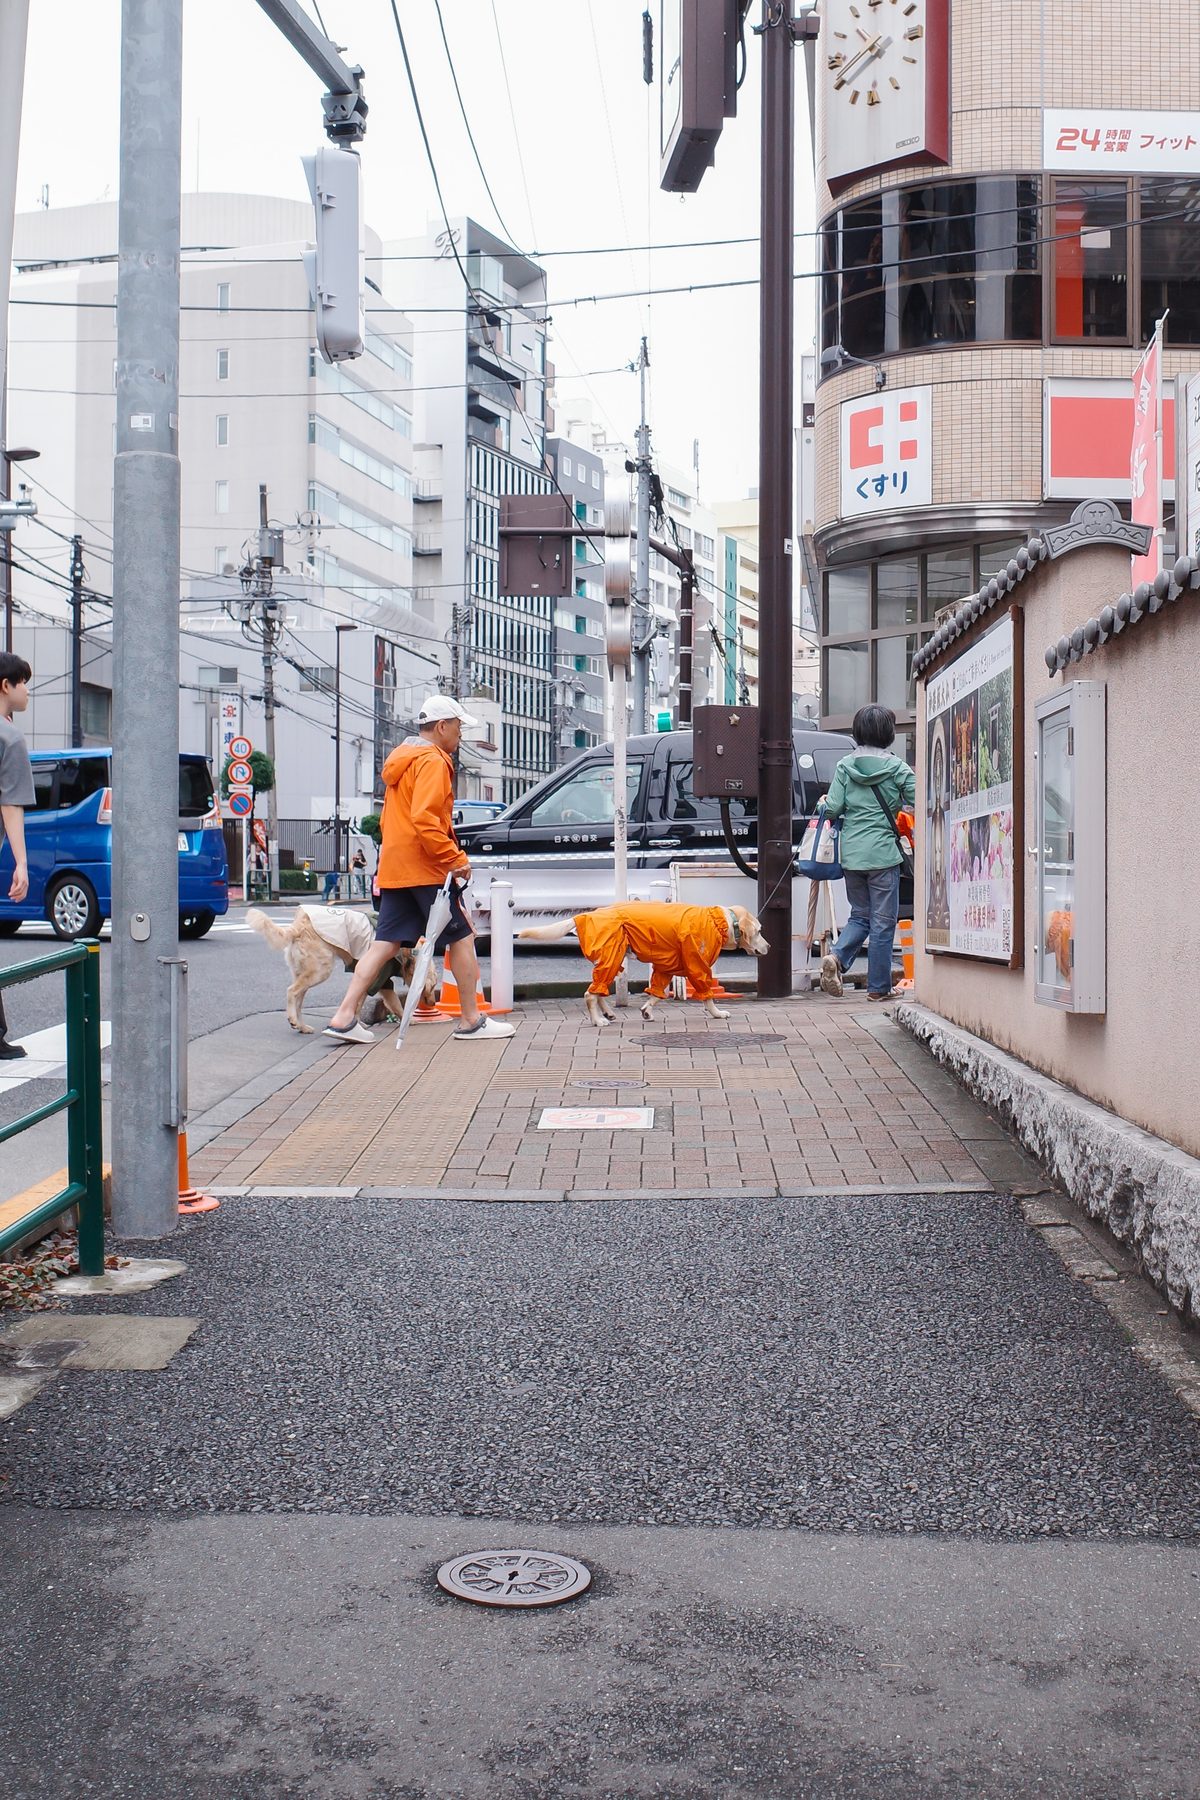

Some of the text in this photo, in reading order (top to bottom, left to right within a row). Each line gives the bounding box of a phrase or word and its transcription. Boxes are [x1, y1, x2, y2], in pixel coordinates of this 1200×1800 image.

[1056, 128, 1132, 152] 24 時間
[1103, 141, 1129, 153] 営業
[1140, 135, 1197, 151] フィット
[856, 471, 908, 499] くすり
[234, 743, 247, 754] 40
